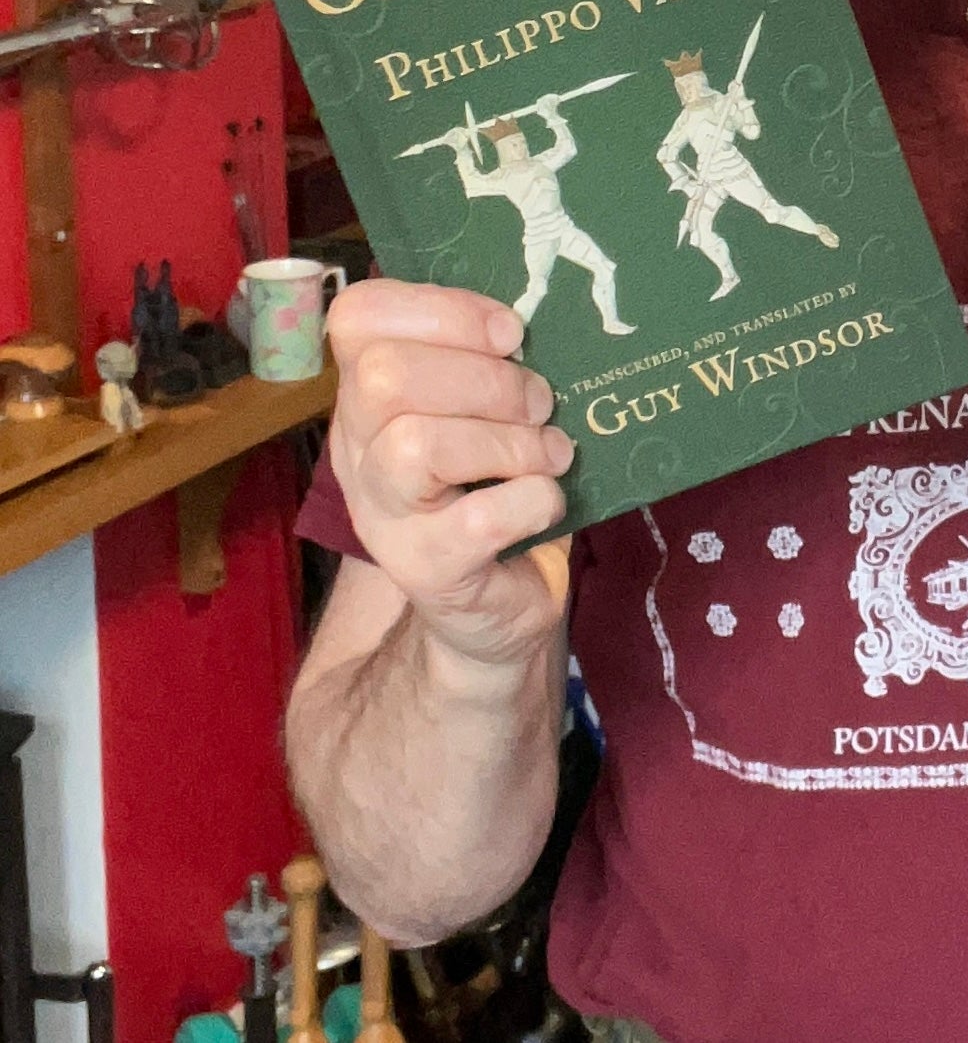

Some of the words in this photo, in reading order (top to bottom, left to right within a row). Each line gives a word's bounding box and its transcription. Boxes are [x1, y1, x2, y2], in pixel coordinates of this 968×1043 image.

[375, 1, 601, 101] PHILIPPO
[570, 346, 690, 394] TRANSCRIBED,
[693, 330, 726, 353] AND
[730, 291, 834, 336] TRANSLATED
[839, 282, 858, 299] BY
[586, 384, 682, 436] GUY
[688, 312, 895, 397] WINDSOR
